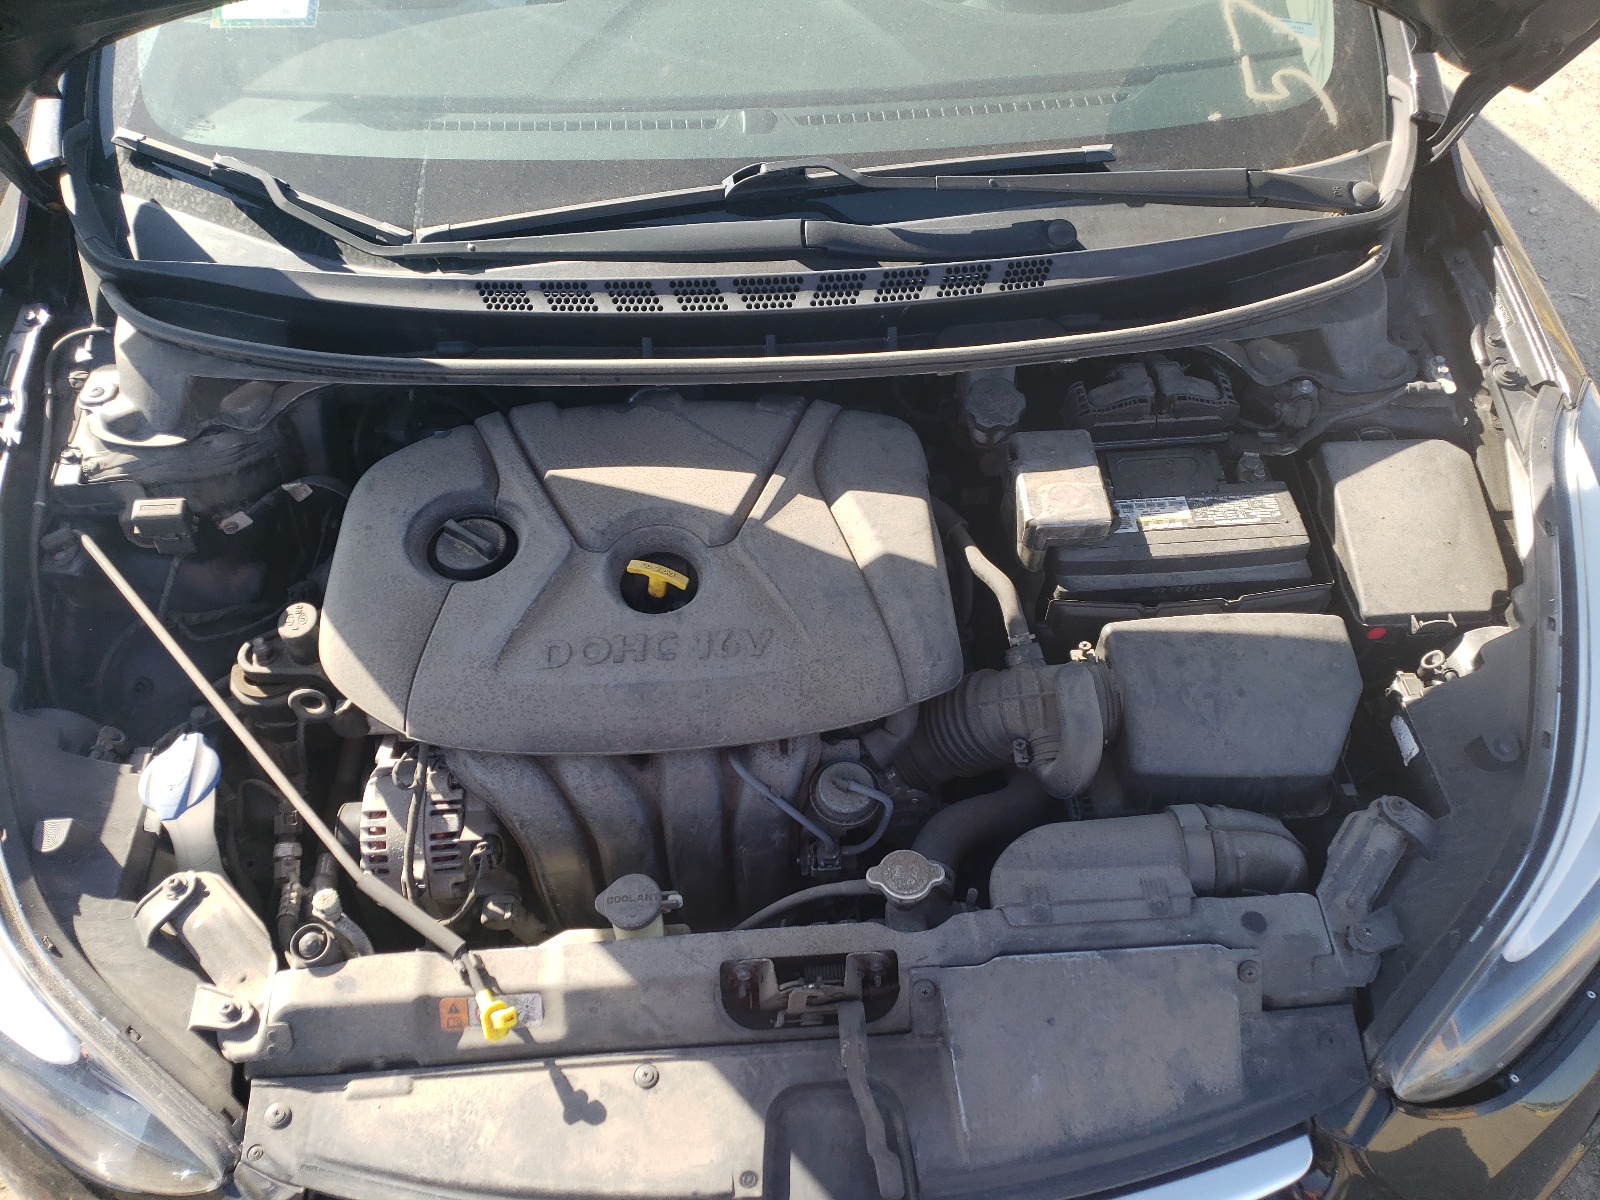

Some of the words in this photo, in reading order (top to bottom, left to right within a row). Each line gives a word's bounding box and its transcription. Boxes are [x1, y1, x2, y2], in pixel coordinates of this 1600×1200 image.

[538, 631, 679, 670] DOHC
[696, 628, 775, 660] 16V
[606, 893, 659, 905] COOLANT
